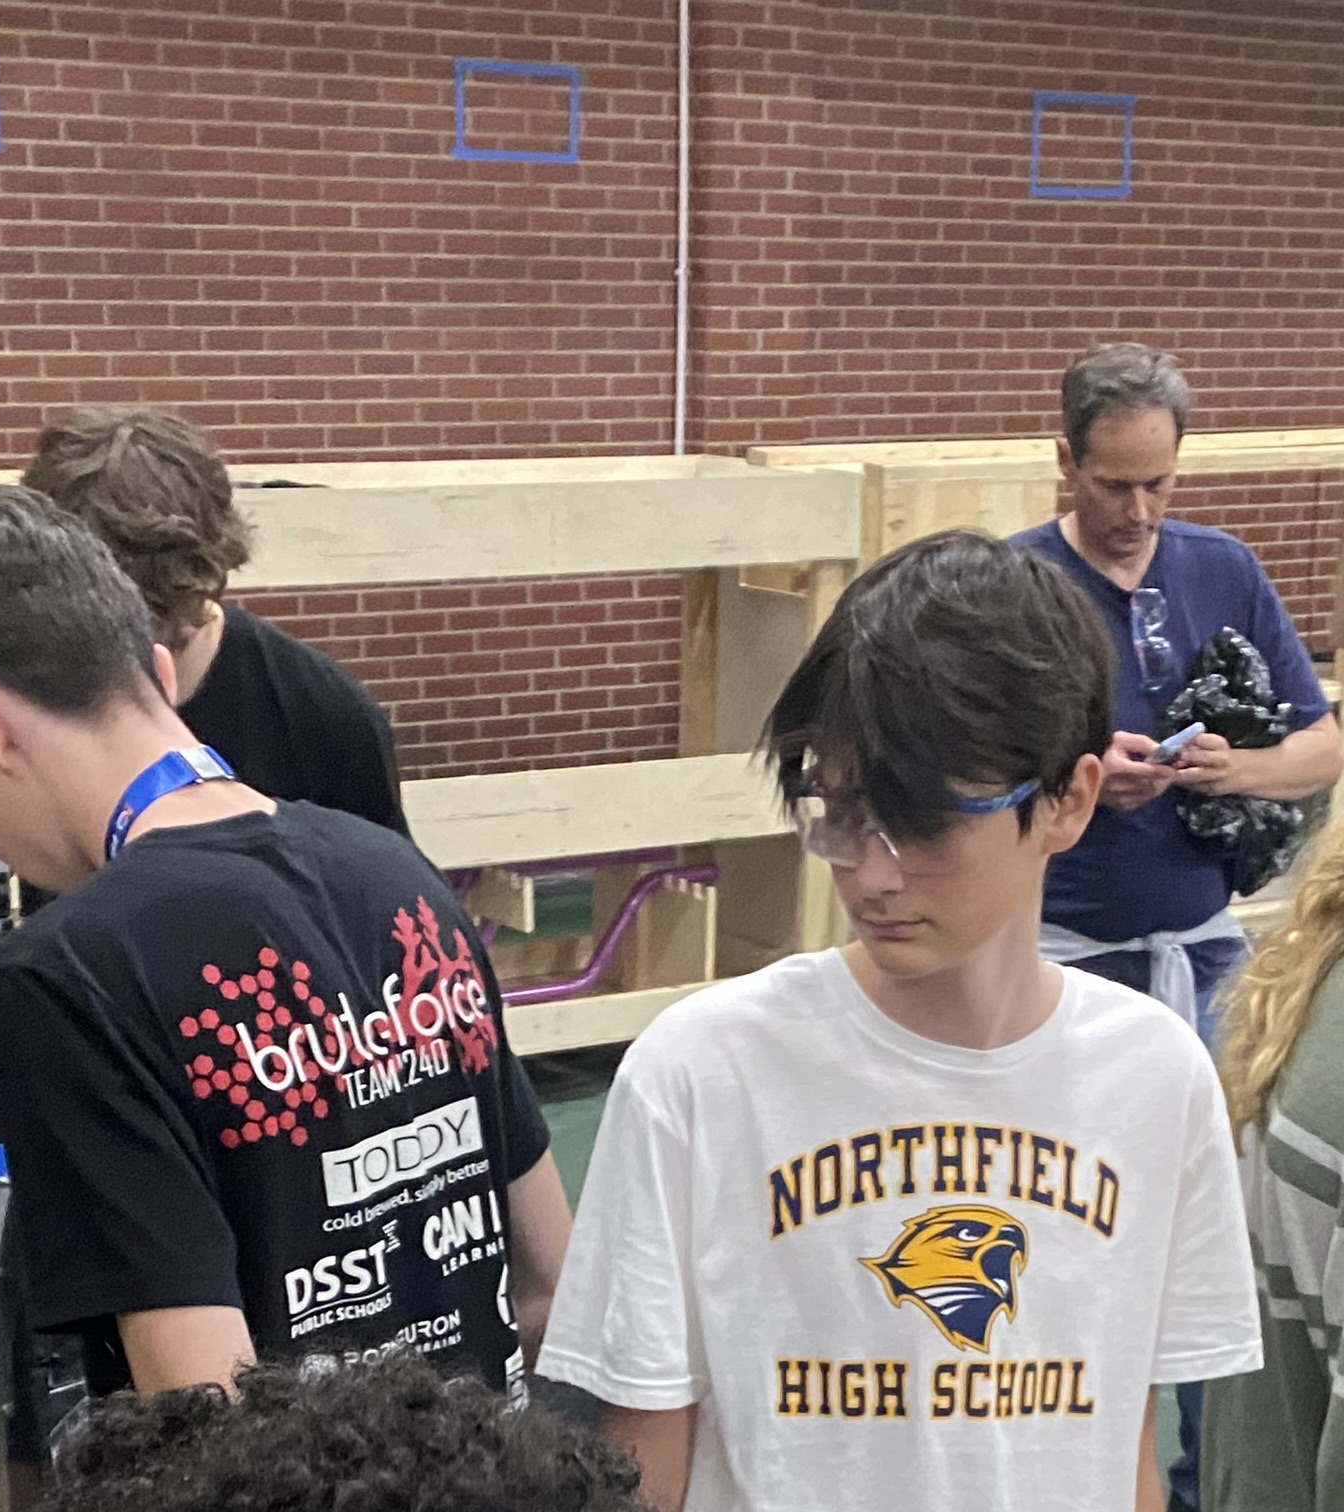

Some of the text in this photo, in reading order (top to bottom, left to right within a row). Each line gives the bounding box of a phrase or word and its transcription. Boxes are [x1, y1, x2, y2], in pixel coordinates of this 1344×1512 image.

[342, 1038, 450, 1109] TEAM 240
[333, 1109, 470, 1193] TODDY
[768, 1122, 1121, 1240] NORTHFIELD
[322, 1210, 363, 1232] cold
[422, 1195, 485, 1260] CAN
[284, 1239, 389, 1315] DSST
[290, 1292, 393, 1339] PUBLIC SCHOOLS
[776, 1358, 1095, 1420] HIGH SCHOOL
